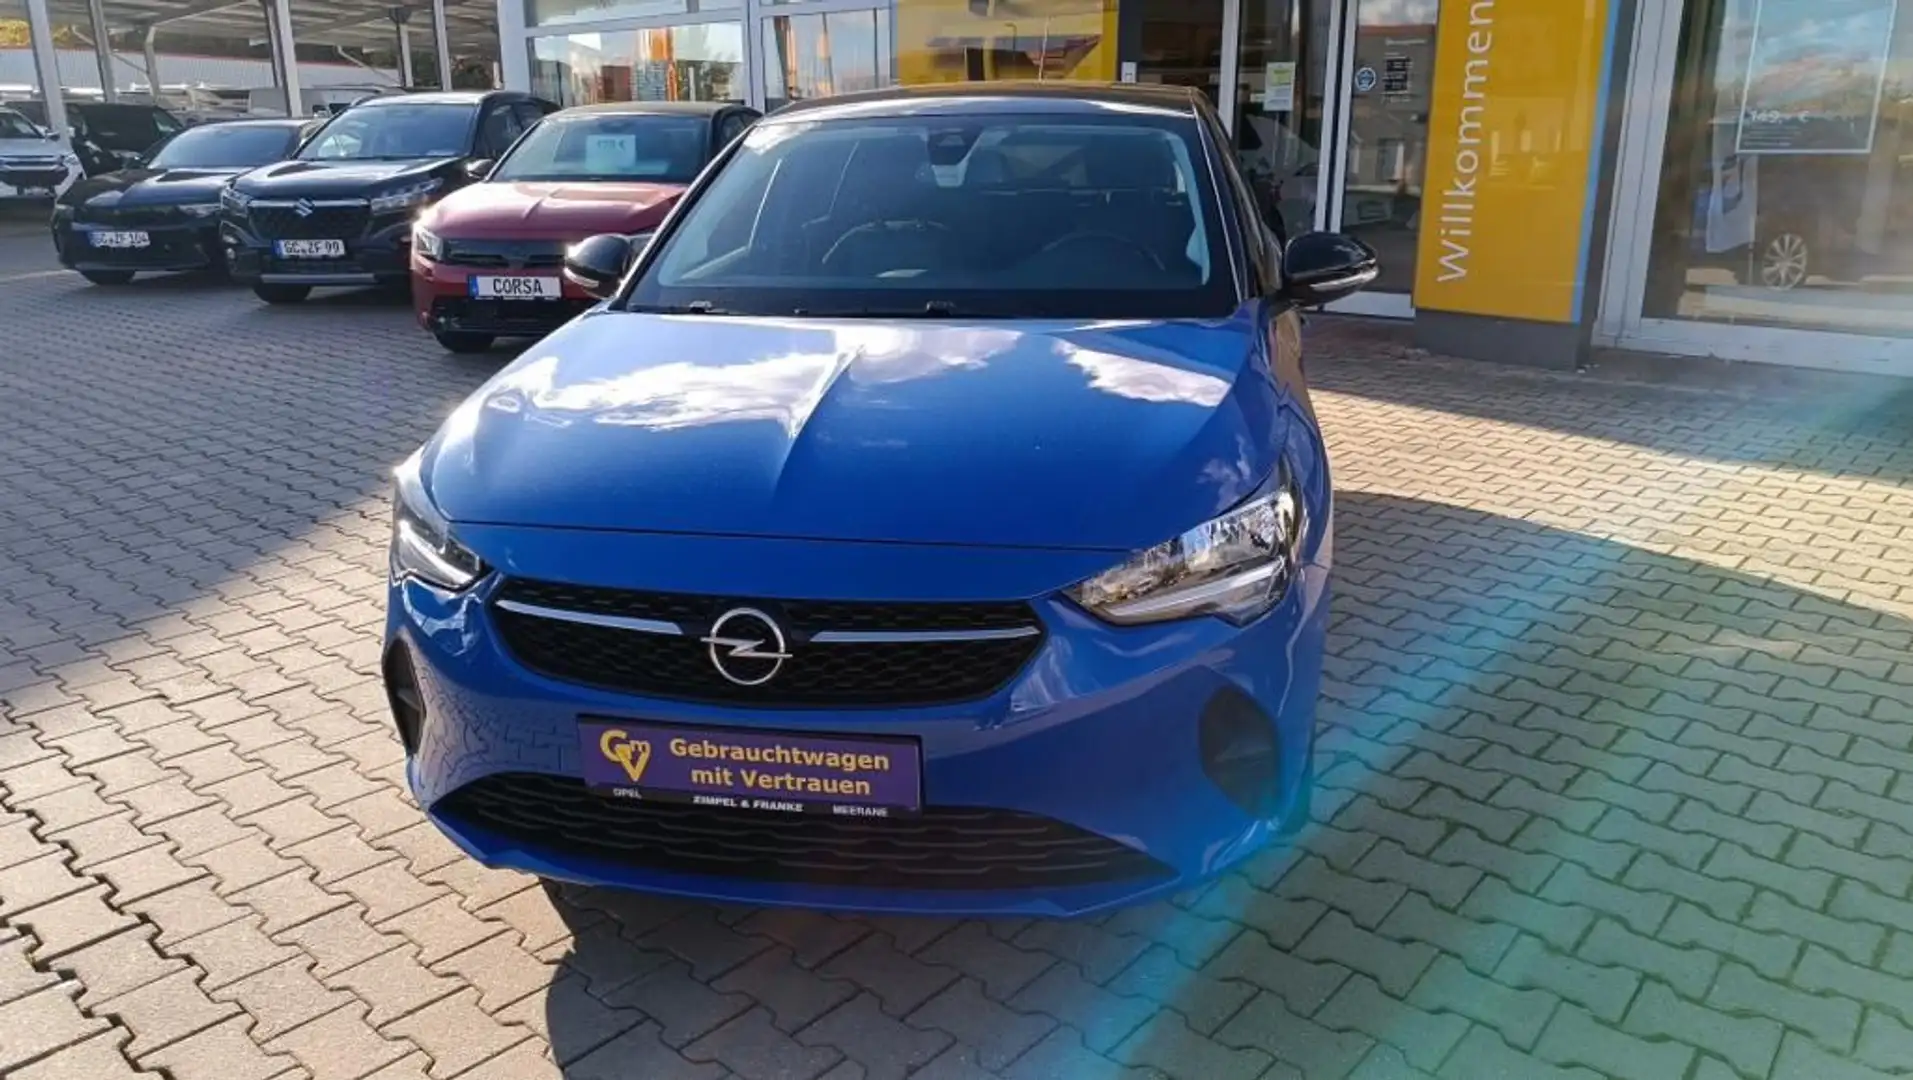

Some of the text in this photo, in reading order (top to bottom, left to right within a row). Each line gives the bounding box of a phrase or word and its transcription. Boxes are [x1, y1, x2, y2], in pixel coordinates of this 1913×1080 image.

[1436, 0, 1495, 282] Willkommen
[492, 278, 544, 295] CORSA
[669, 738, 890, 771] Gebrauchtwagen
[690, 765, 871, 796] mit Vertrauen
[613, 787, 642, 799] OPEL
[693, 795, 738, 808] ZIMPEL
[753, 800, 804, 813] FRANKE
[833, 804, 888, 818] MEERANE
